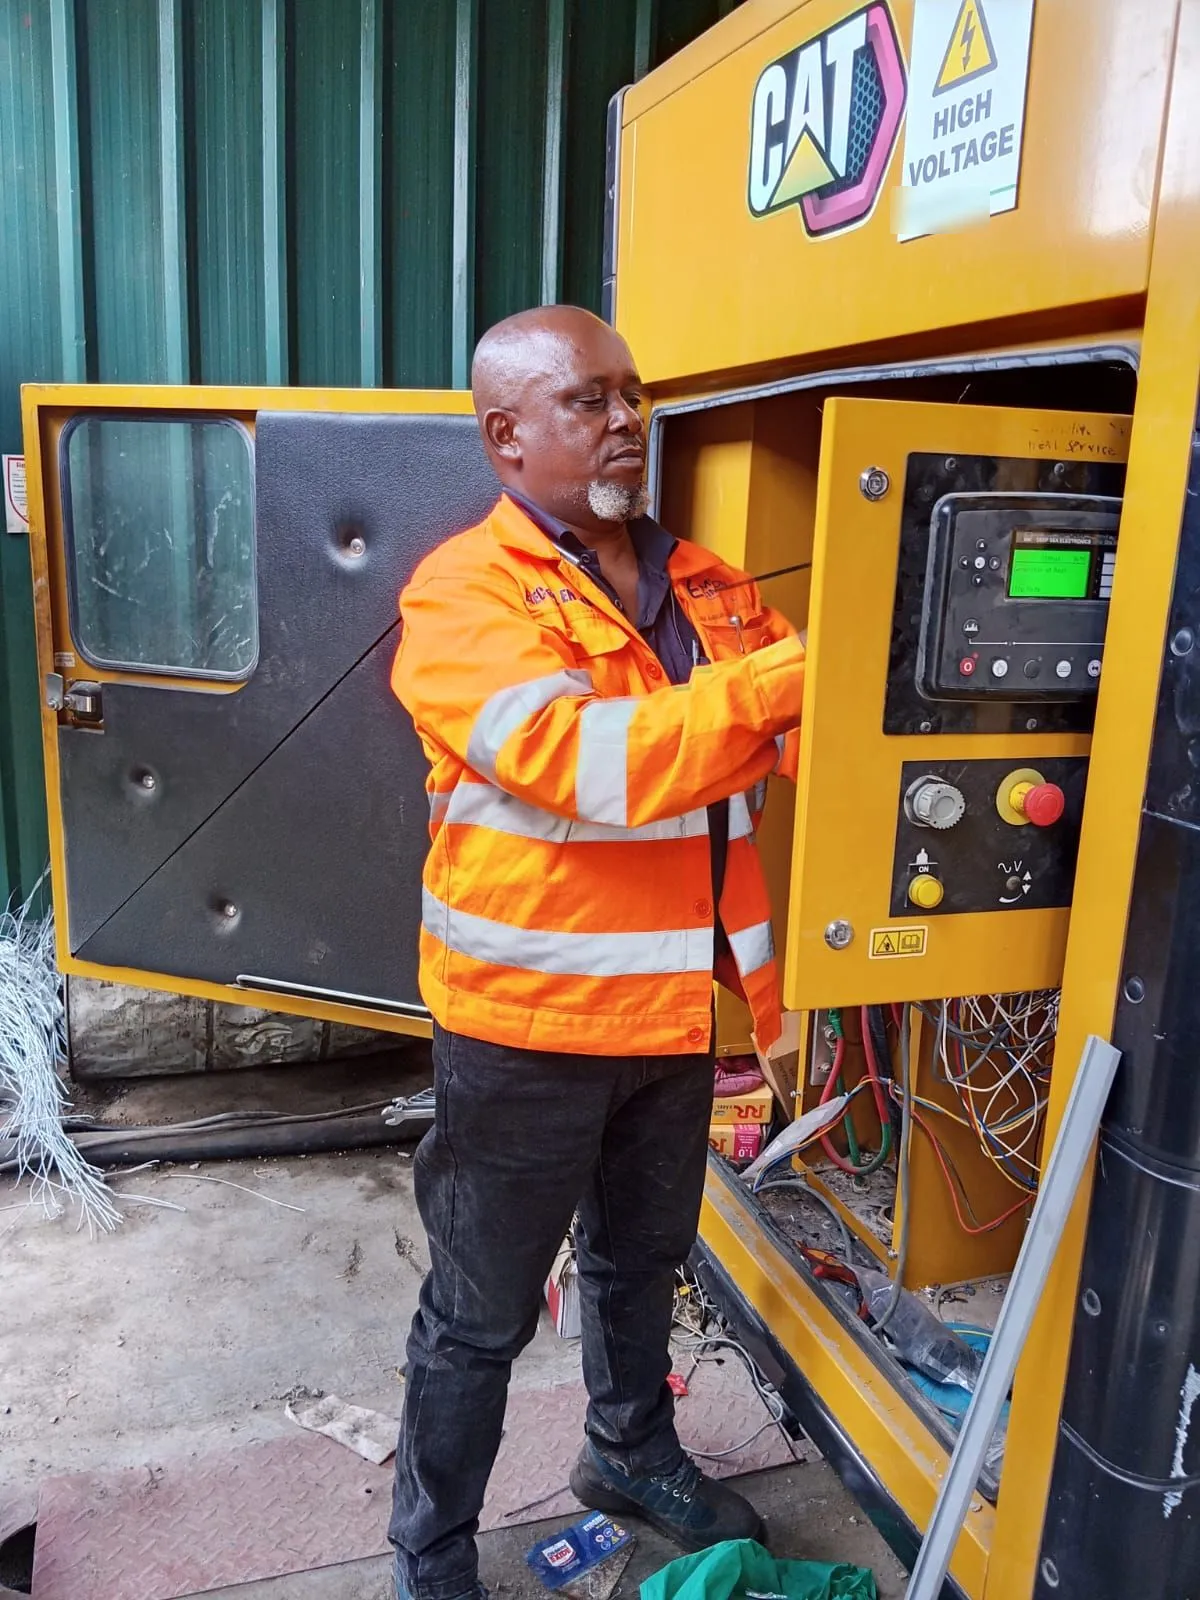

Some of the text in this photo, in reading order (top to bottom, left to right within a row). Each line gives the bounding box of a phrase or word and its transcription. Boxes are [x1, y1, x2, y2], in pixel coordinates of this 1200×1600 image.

[750, 11, 868, 212] CAT
[932, 89, 992, 140] HIGH
[909, 124, 1015, 187] VOLTAGE
[918, 865, 929, 873] ON
